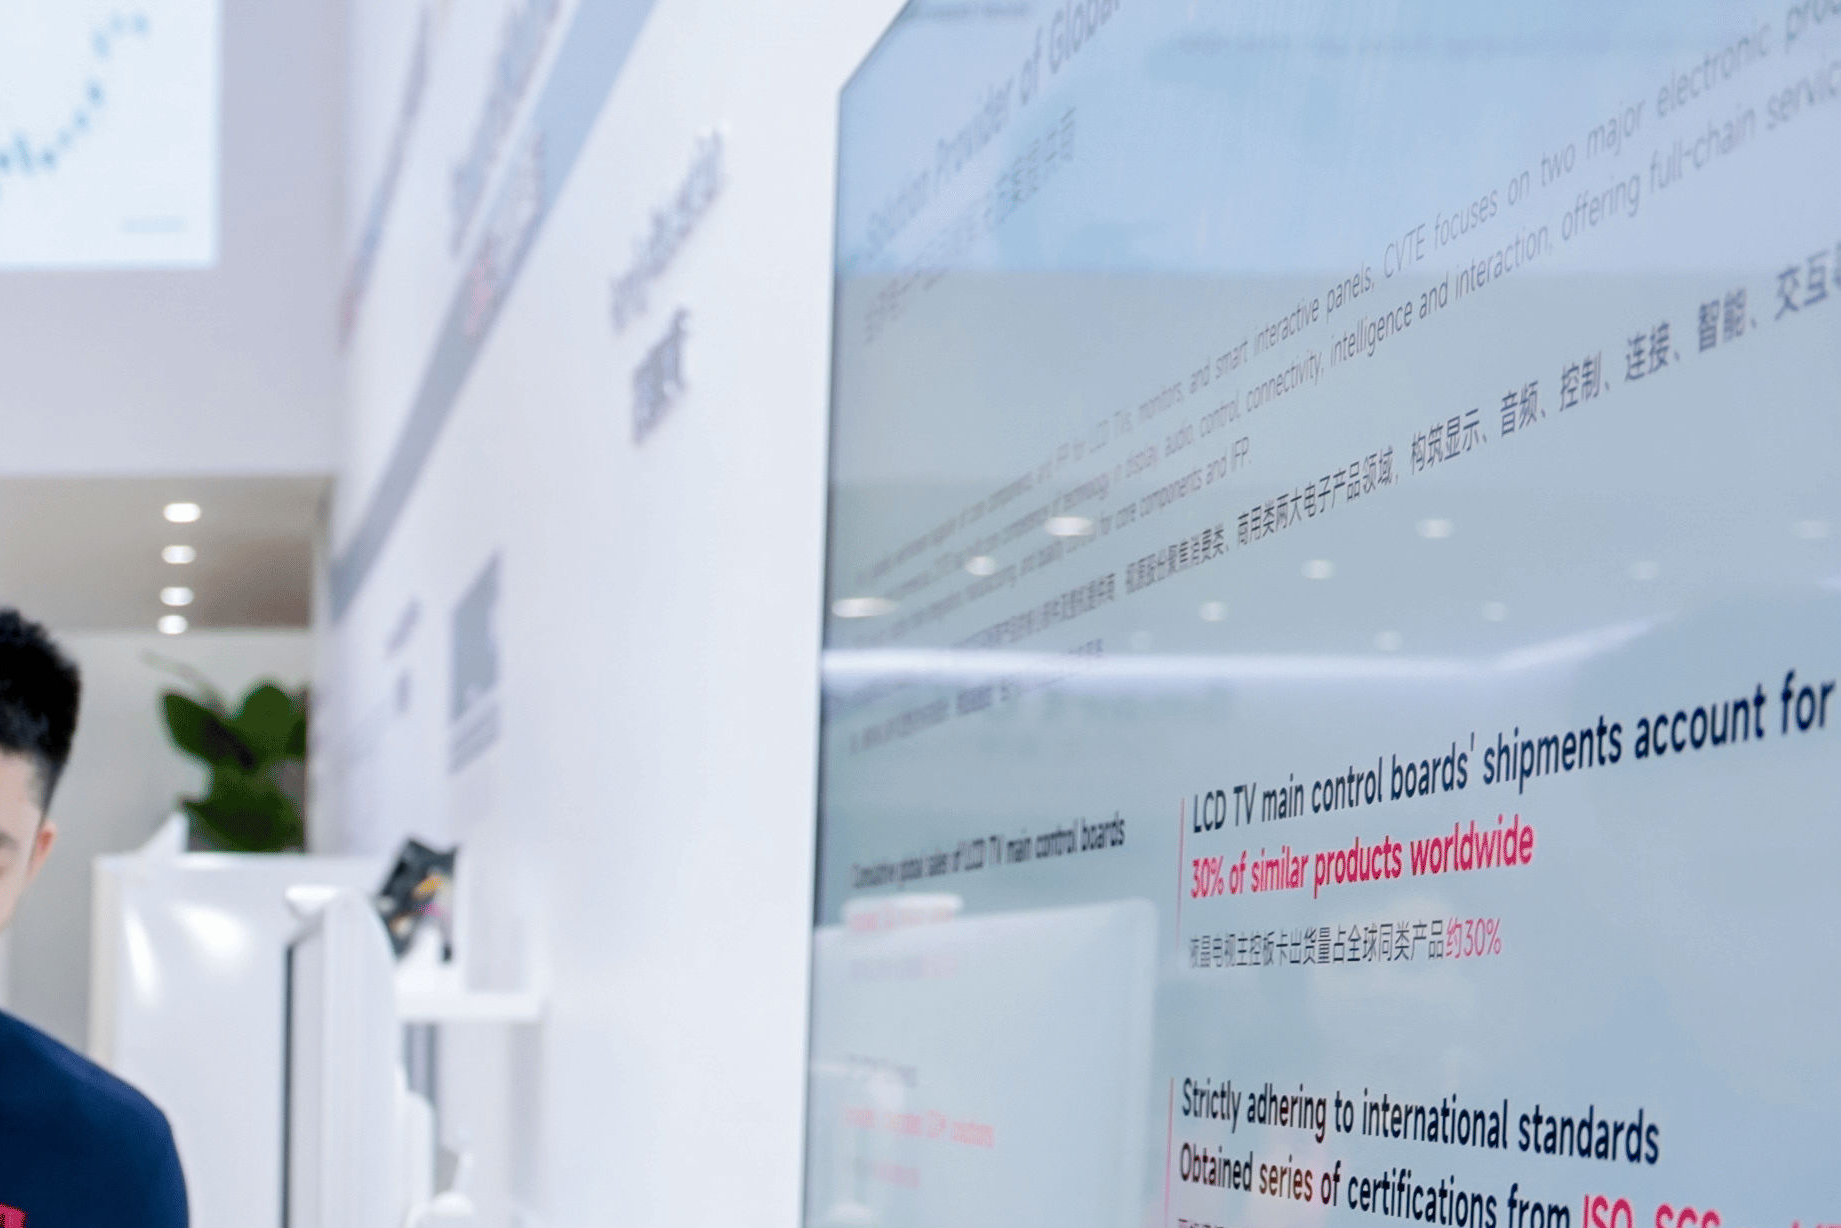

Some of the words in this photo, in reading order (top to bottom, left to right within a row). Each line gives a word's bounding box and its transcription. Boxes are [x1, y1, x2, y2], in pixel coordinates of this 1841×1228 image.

[1253, 295, 1319, 356] interactive
[1326, 261, 1375, 324] panels,
[1383, 223, 1426, 279] CVTE
[1433, 189, 1498, 250] focuses
[1507, 169, 1530, 206] on
[1540, 142, 1575, 187] two
[1586, 98, 1645, 160] major
[1657, 20, 1770, 119] electronic
[1330, 300, 1413, 367] intelligence
[1418, 271, 1448, 321] and
[1455, 224, 1553, 300] interaction,
[1561, 174, 1640, 241] offering
[1650, 103, 1756, 194] full-chain
[1193, 790, 1227, 833] LCD
[1234, 783, 1256, 826] TV
[1262, 773, 1304, 822] main
[1312, 757, 1382, 813] control
[1391, 732, 1474, 801] boards'
[1483, 715, 1622, 794] shipments
[1635, 683, 1766, 759] account
[1781, 669, 1835, 735] for
[1081, 810, 1125, 852] boards
[1191, 856, 1224, 898] 30%
[1229, 850, 1247, 894] of
[1251, 846, 1308, 892] similar
[1314, 836, 1402, 899] products
[1410, 813, 1534, 876] worldwide
[1182, 1077, 1241, 1134] Strictly
[1248, 1083, 1326, 1143] adhering
[1335, 1090, 1354, 1133] to
[1363, 1087, 1507, 1150] international
[1518, 1105, 1659, 1165] standards
[1180, 1143, 1253, 1192] Obtained
[1260, 1154, 1313, 1202] series
[1321, 1160, 1341, 1206] of
